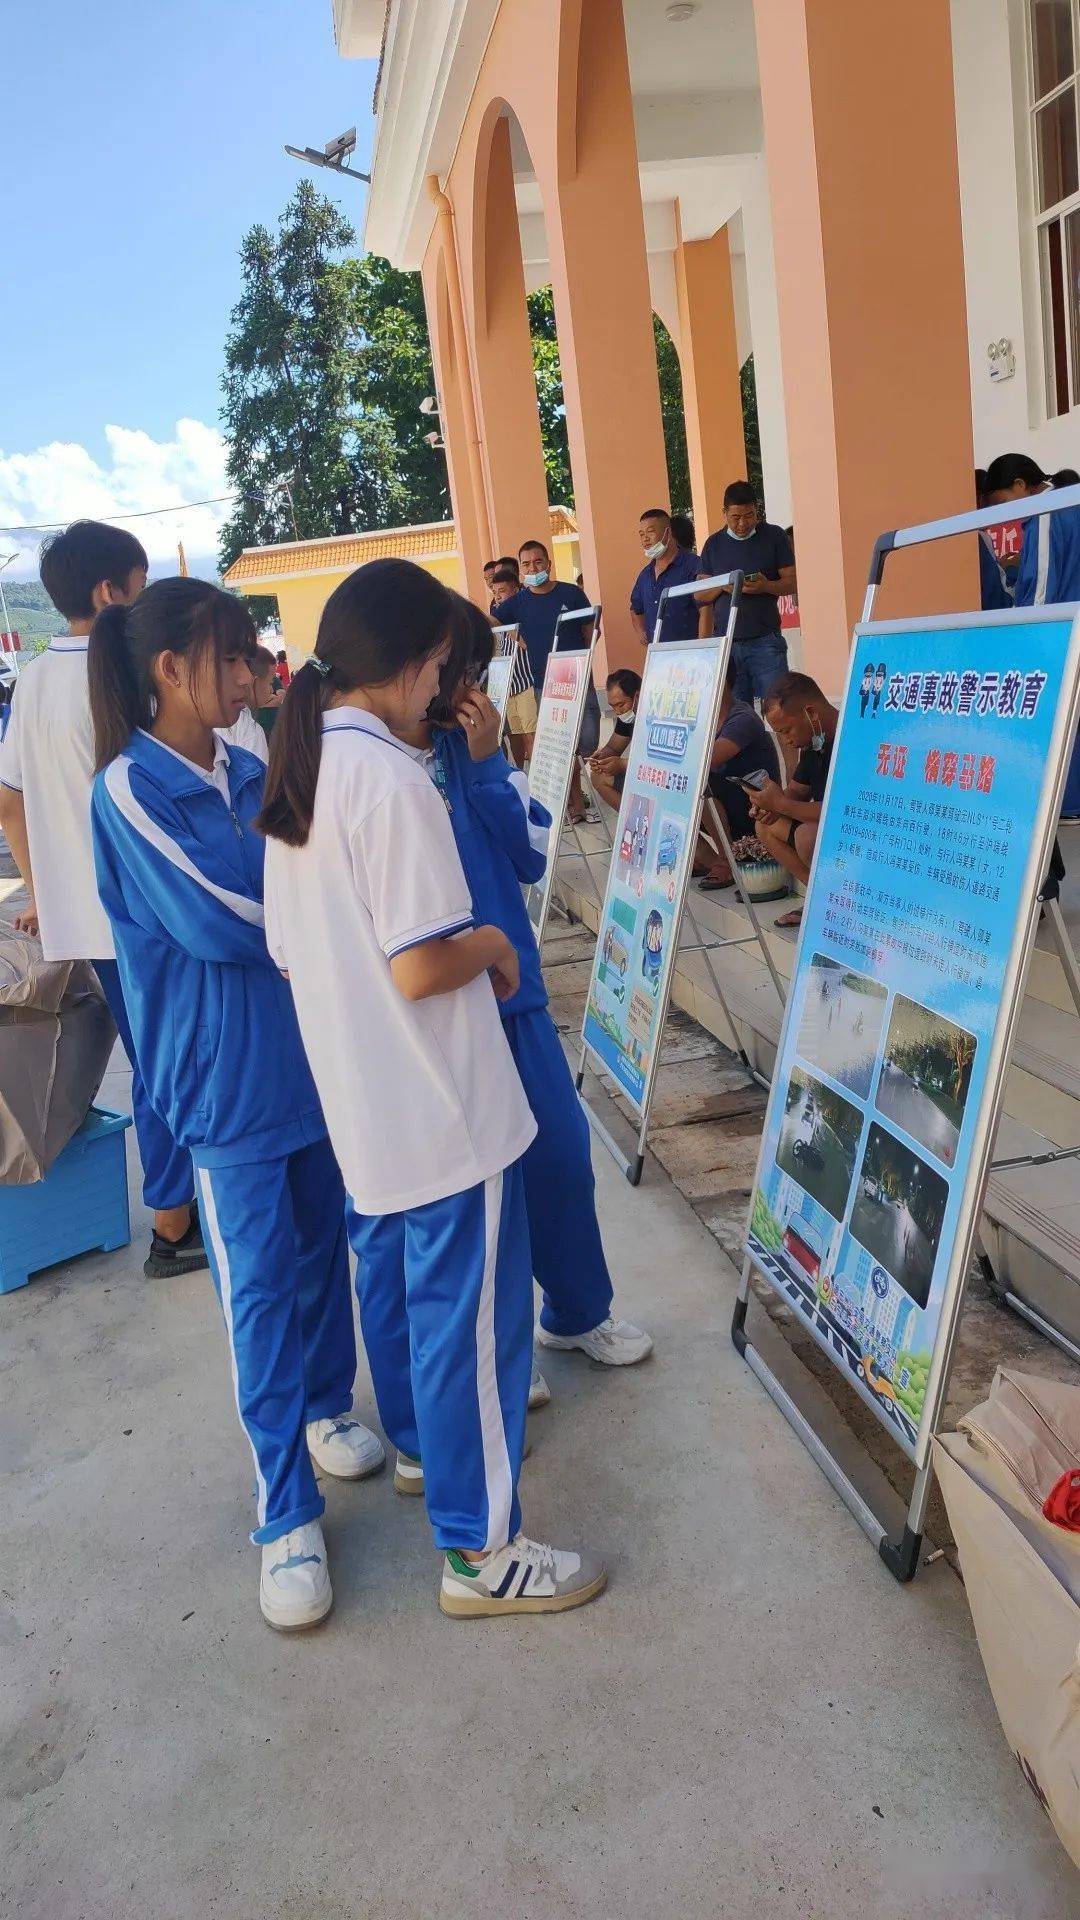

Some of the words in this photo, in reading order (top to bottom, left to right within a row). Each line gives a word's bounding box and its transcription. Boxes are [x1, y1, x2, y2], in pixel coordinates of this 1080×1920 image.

[883, 671, 1047, 718] 交通事故警示教育
[873, 742, 910, 780] 无证
[921, 747, 999, 795] 横穿马路
